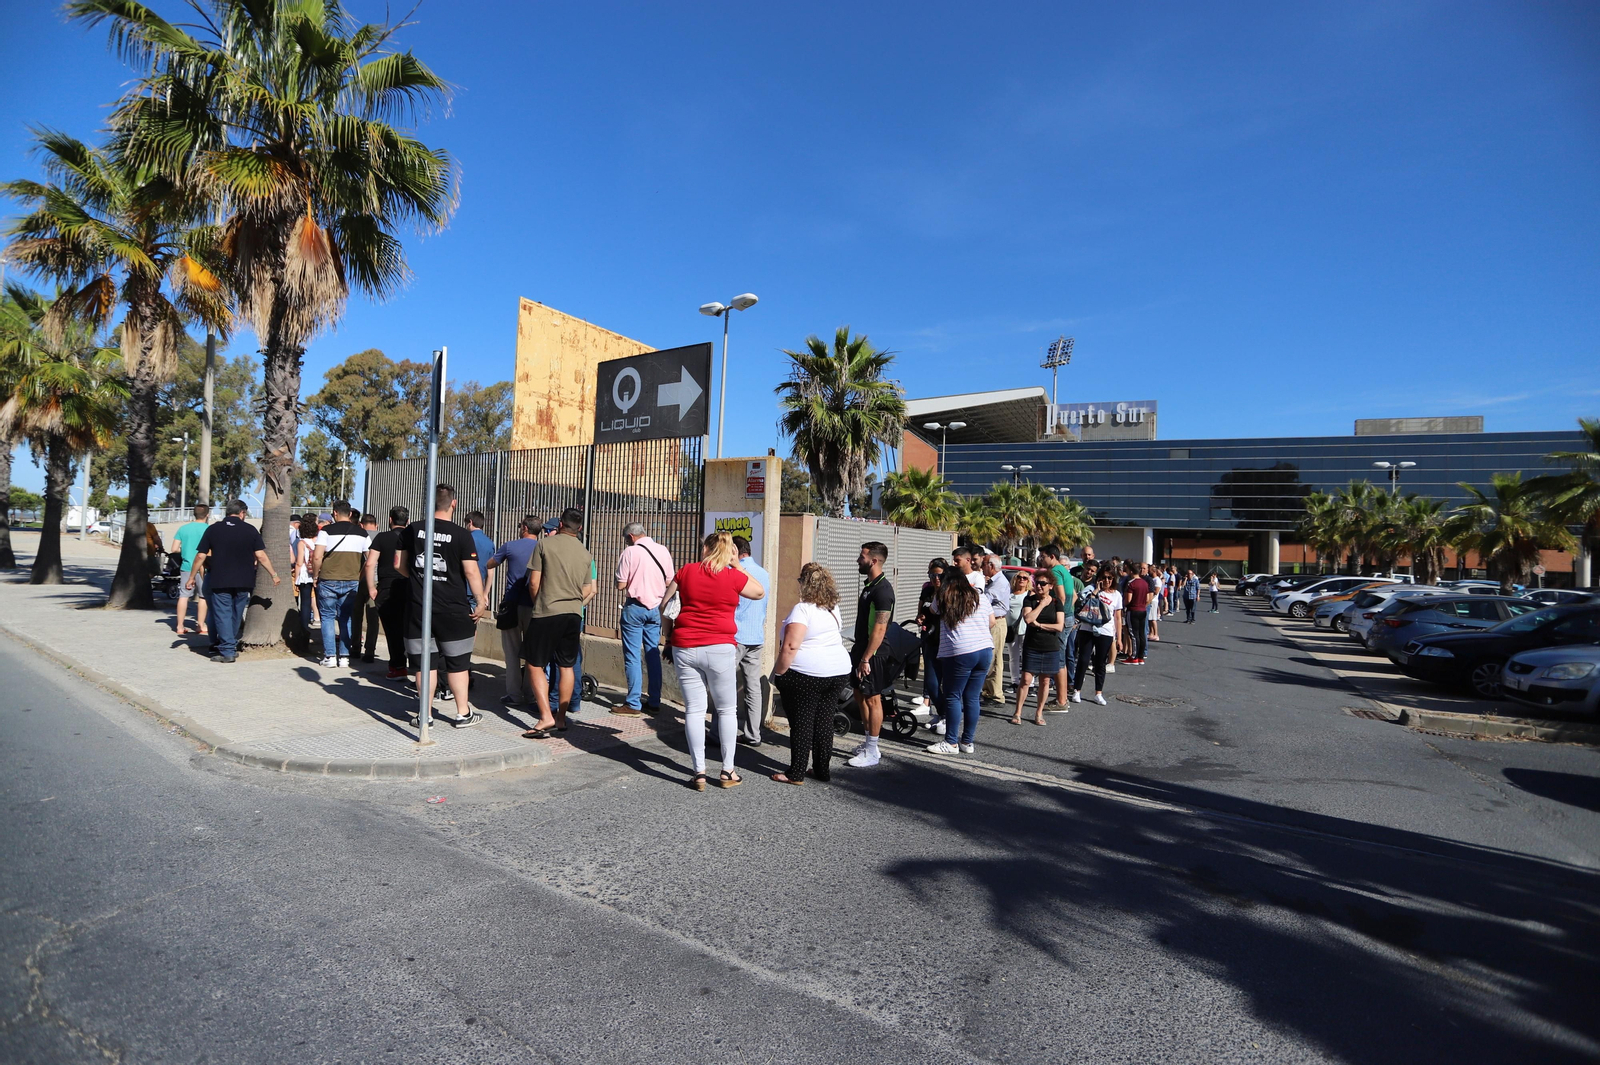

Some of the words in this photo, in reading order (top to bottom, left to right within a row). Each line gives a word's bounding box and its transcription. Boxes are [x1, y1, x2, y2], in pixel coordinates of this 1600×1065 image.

[1044, 403, 1105, 435] Puerto
[1116, 402, 1147, 423] Sur
[418, 530, 451, 542] RIARDO
